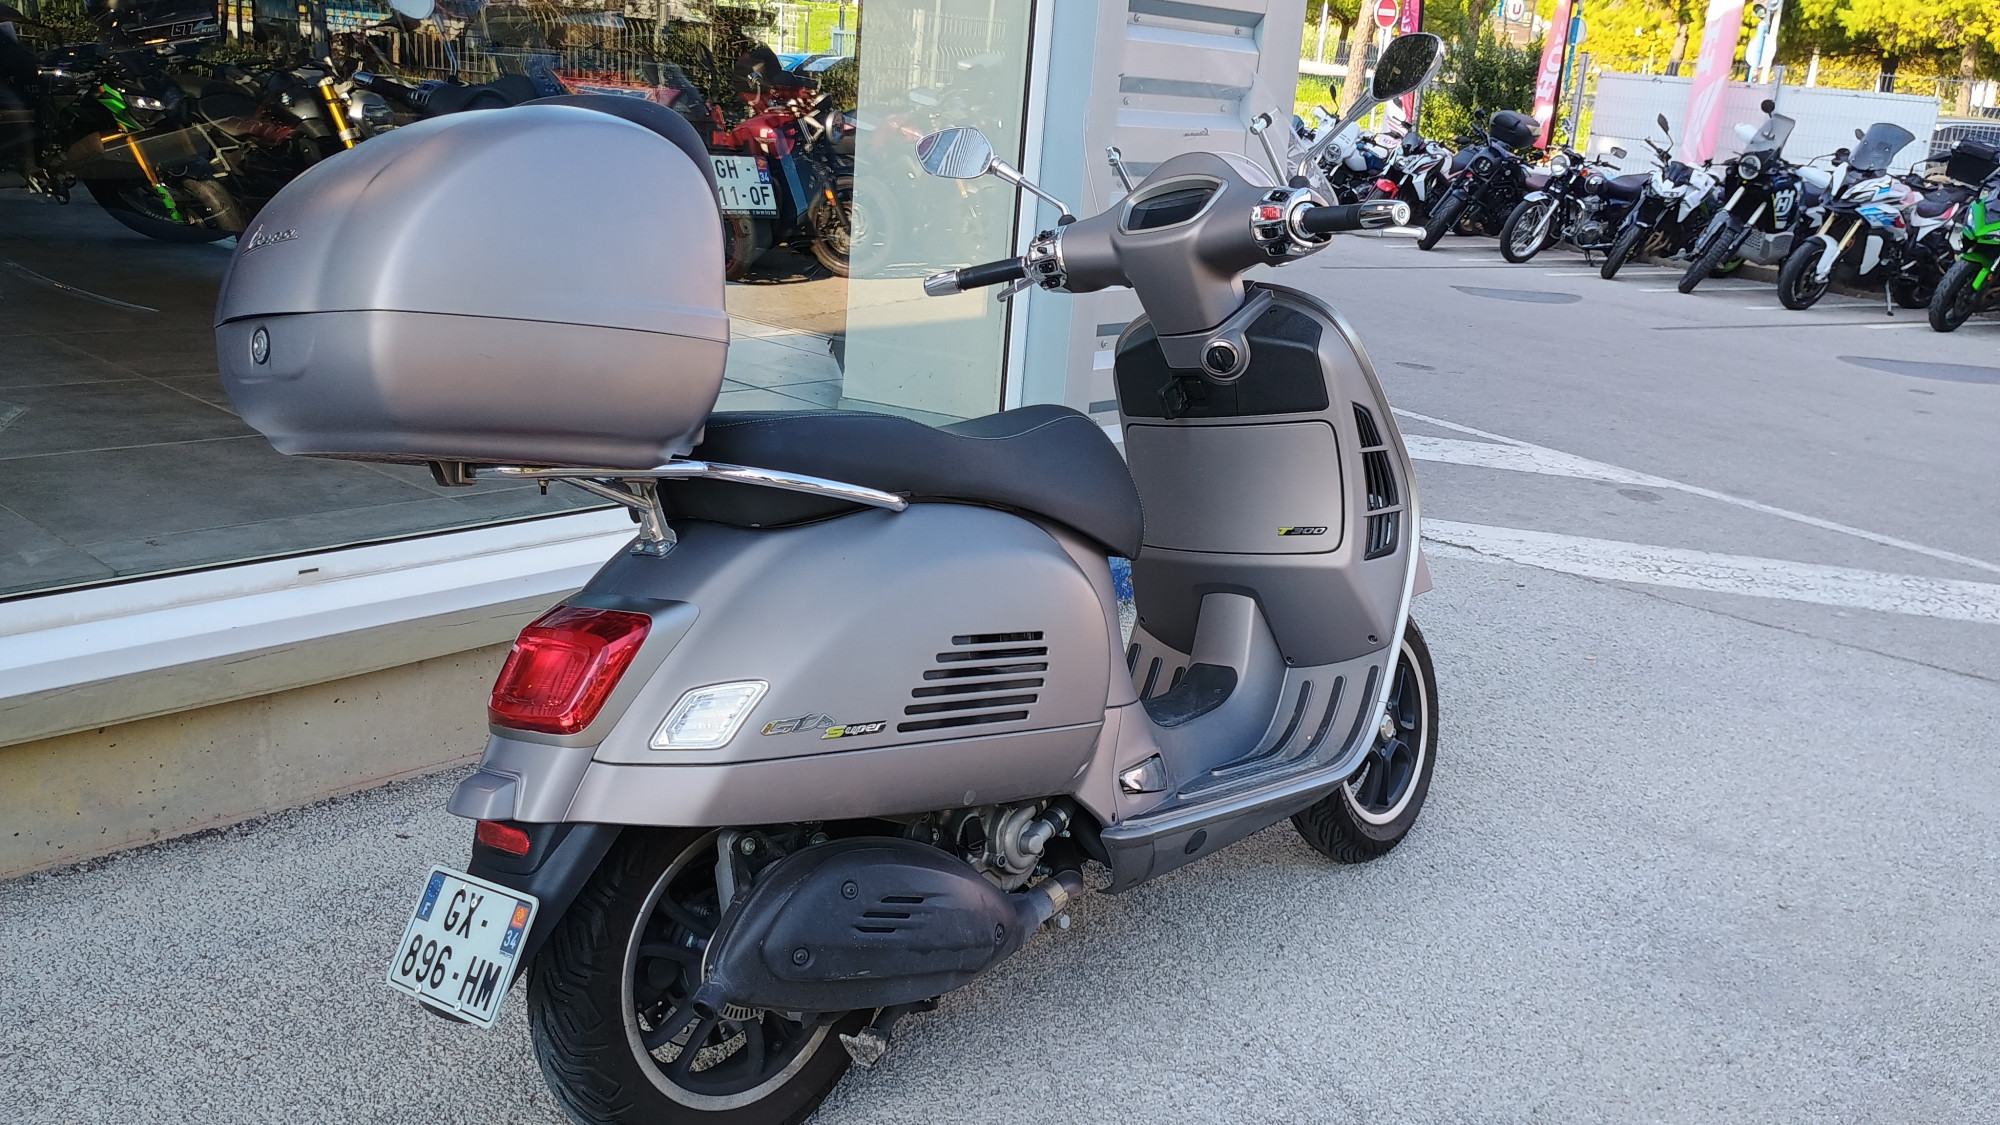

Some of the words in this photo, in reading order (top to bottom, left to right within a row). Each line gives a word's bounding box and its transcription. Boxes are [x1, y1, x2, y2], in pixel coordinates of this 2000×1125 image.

[759, 171, 770, 182] 34
[718, 186, 770, 206] 11-QF
[820, 720, 887, 740] Super
[421, 902, 431, 916] F
[503, 929, 519, 950] 34
[401, 934, 503, 1012] 896-HM
